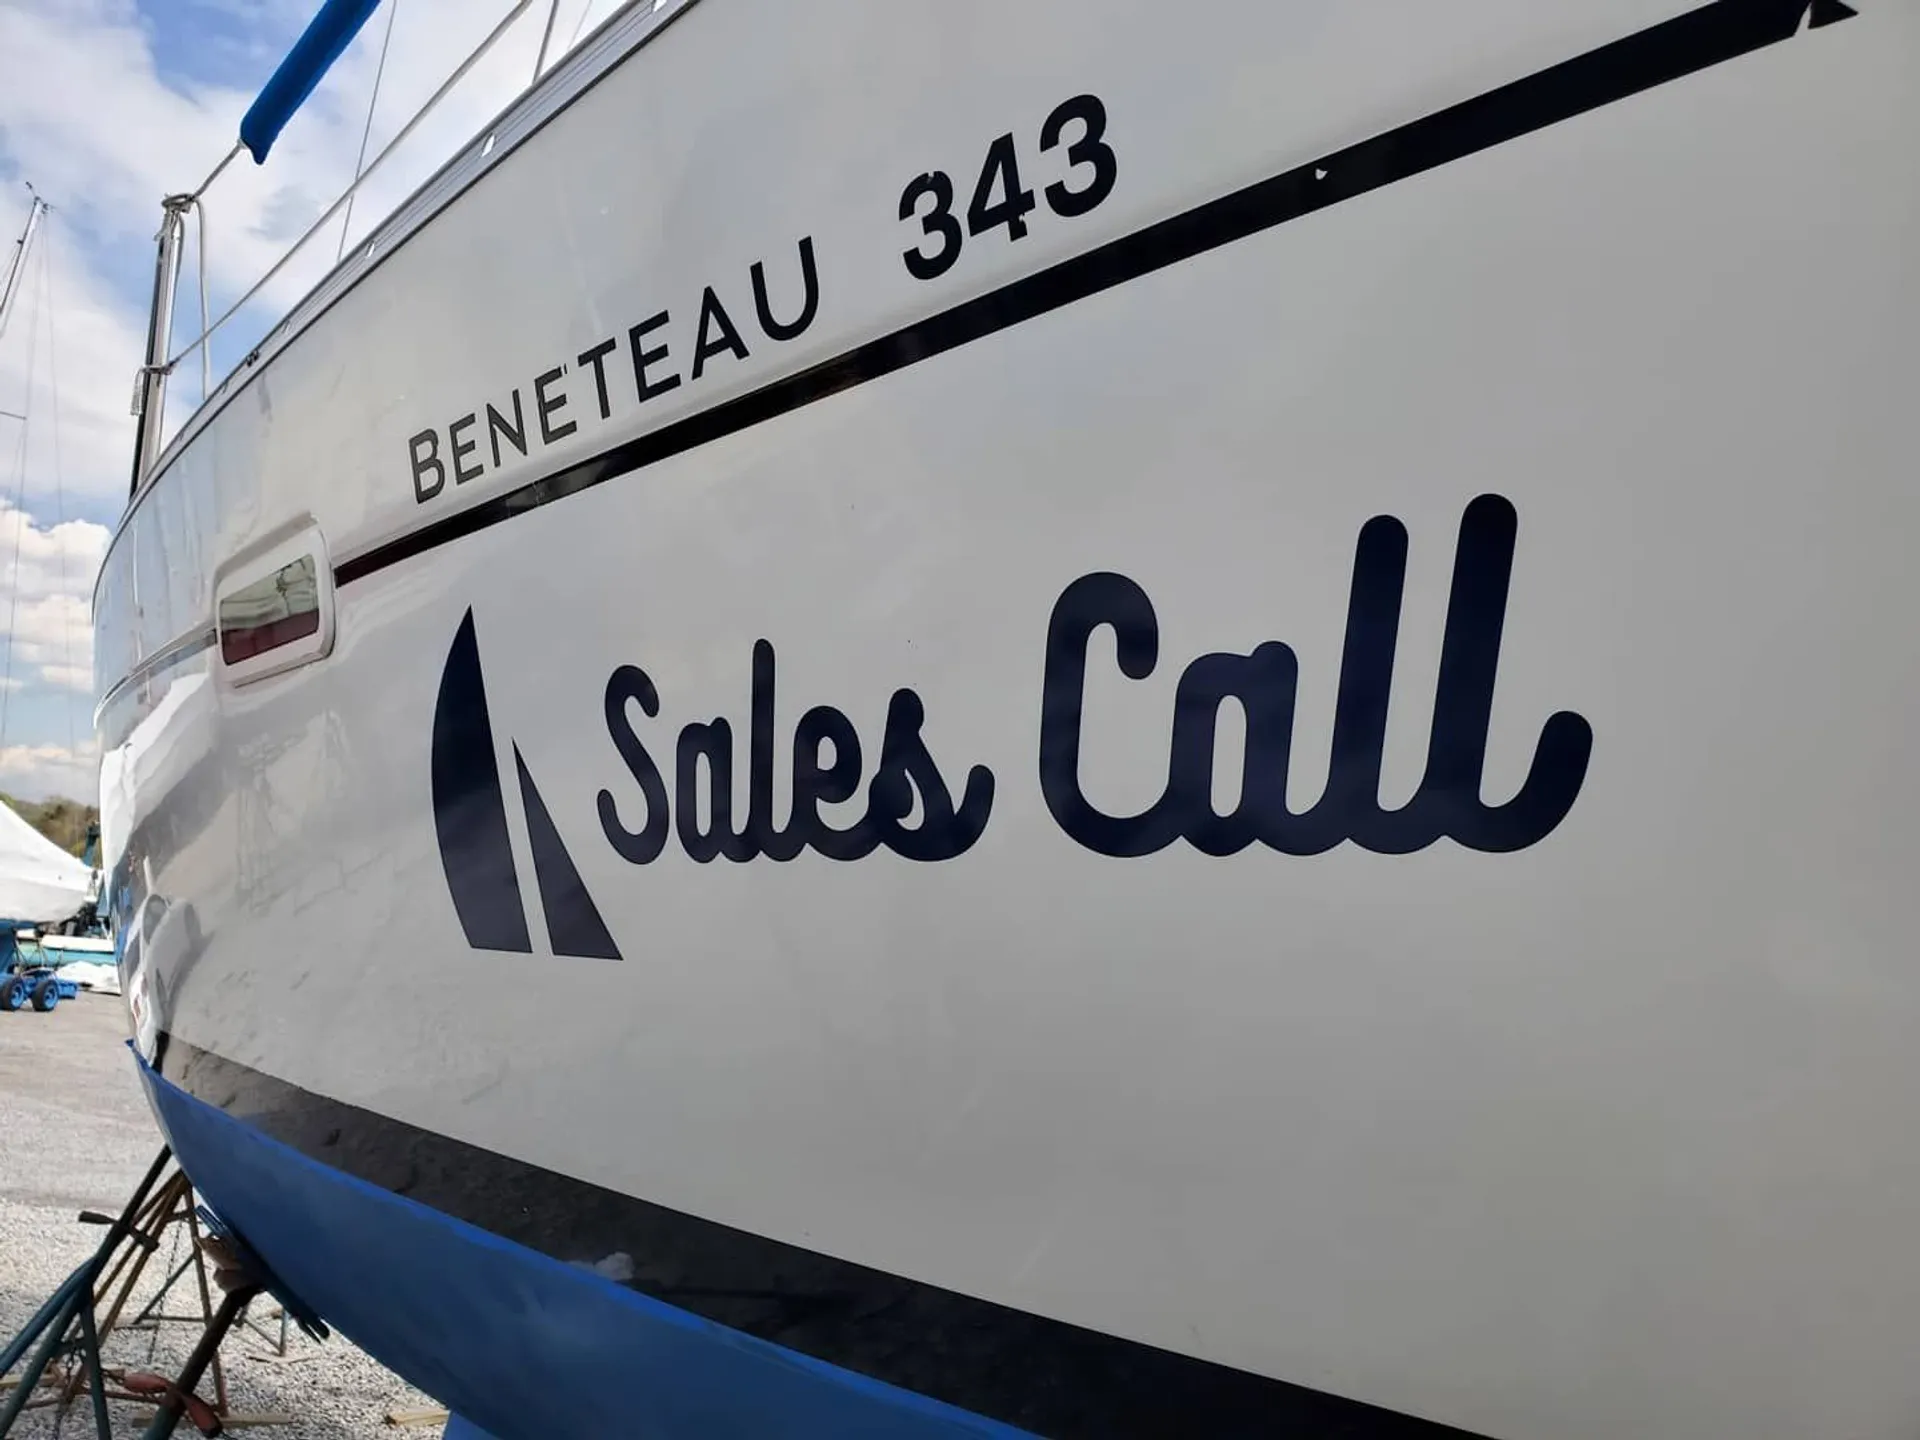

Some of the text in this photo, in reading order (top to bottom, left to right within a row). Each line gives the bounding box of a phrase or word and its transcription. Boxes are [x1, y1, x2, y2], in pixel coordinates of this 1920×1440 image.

[408, 94, 1118, 505] BENETEAU 343
[596, 493, 1594, 866] Sales Call
